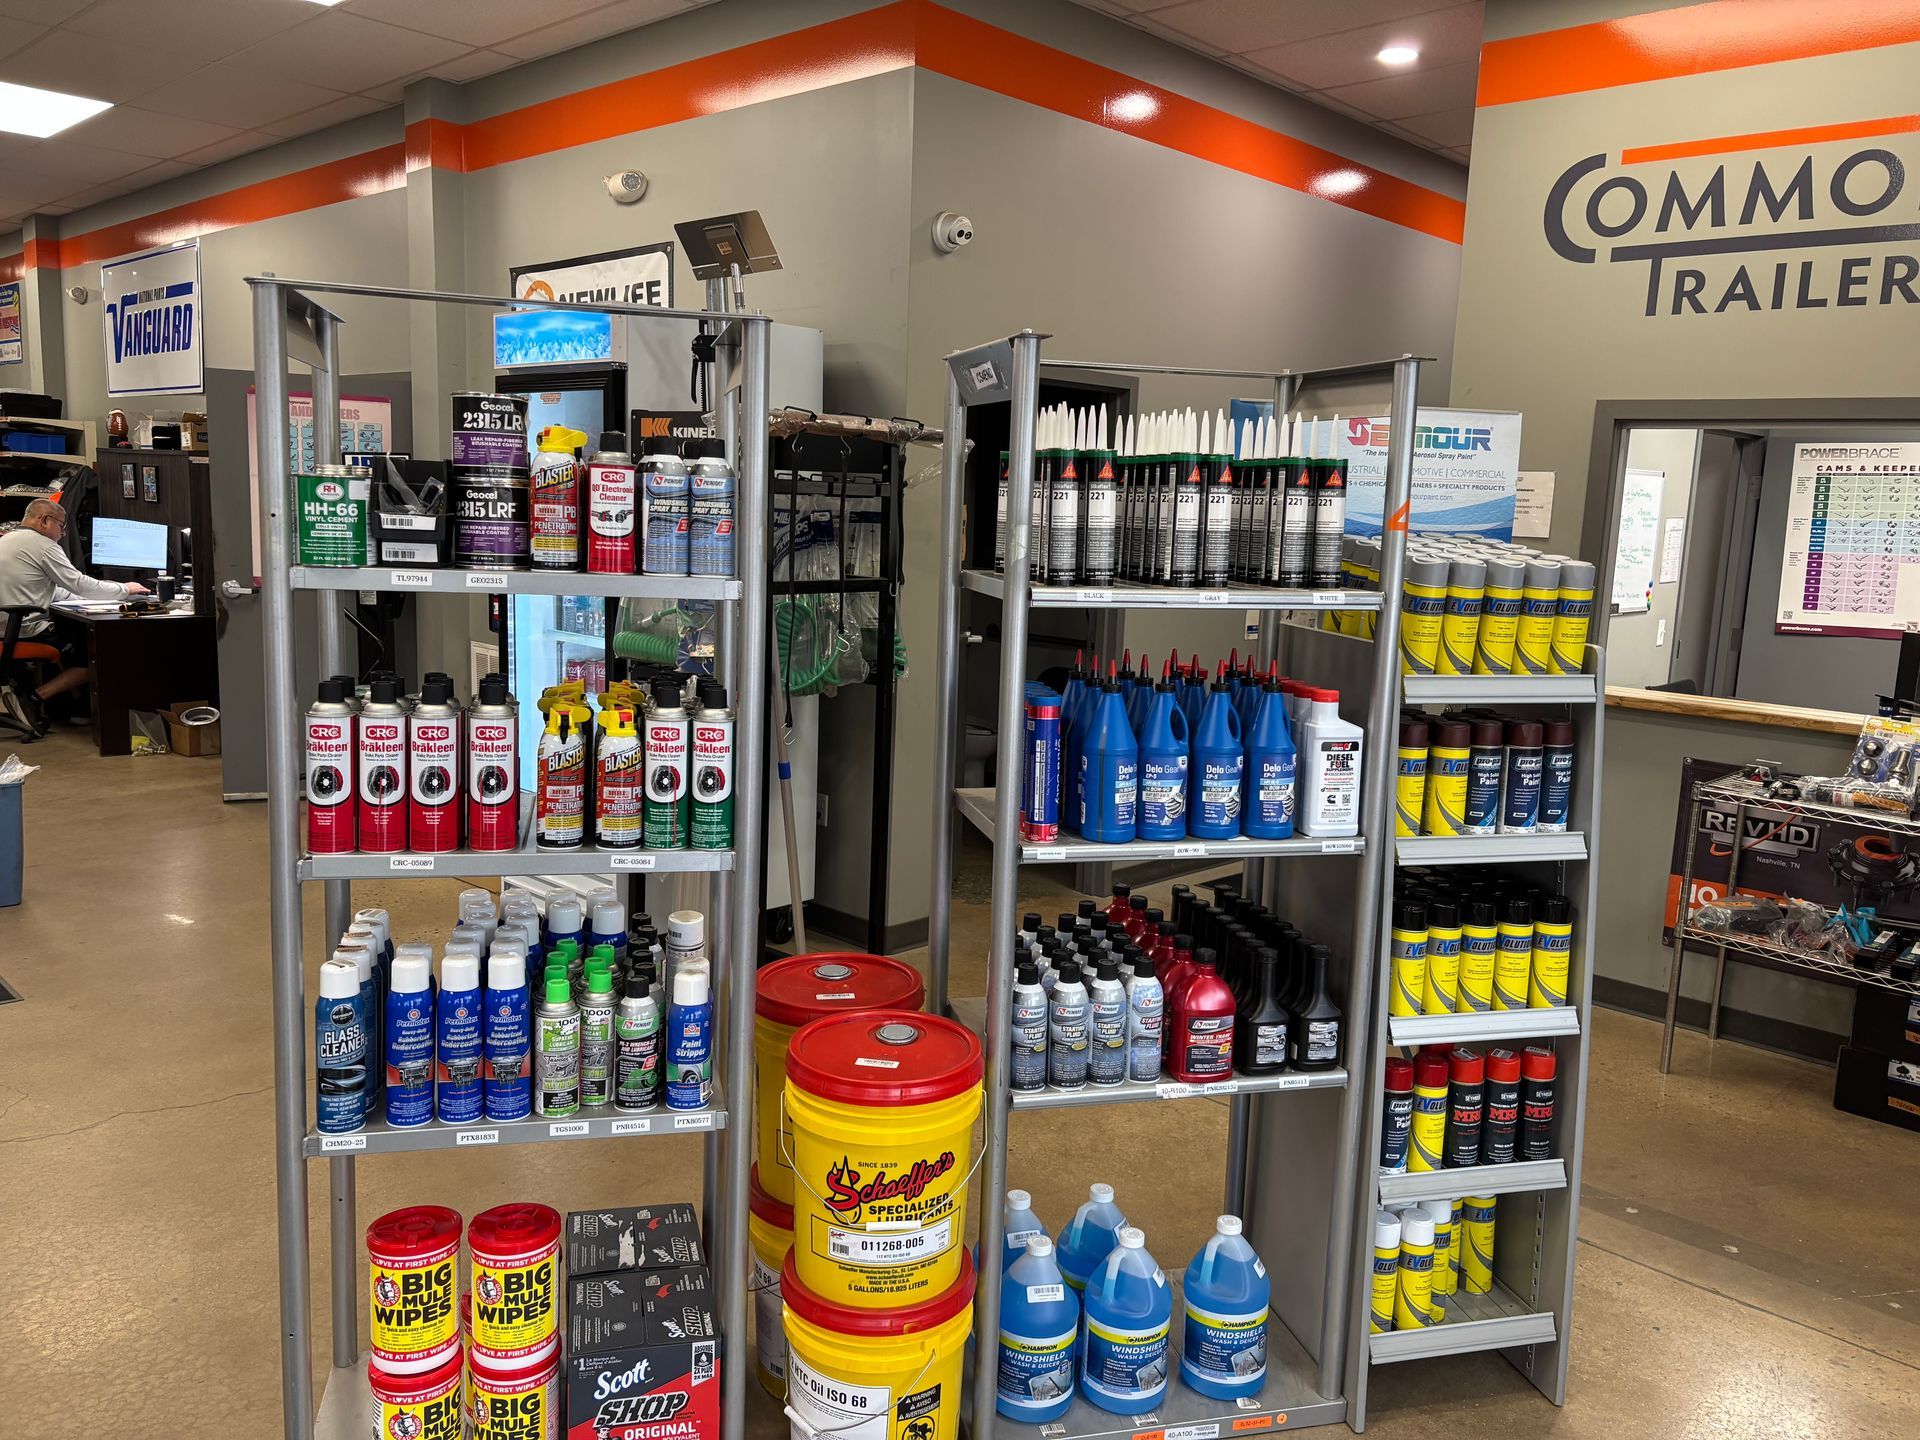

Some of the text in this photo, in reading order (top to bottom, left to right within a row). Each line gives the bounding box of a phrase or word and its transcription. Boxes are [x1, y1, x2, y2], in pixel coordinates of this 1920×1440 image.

[1544, 149, 1920, 263] COMMO
[107, 300, 193, 363] VANGUARD
[481, 401, 513, 412] Geocel
[463, 412, 501, 429] 2315
[1347, 417, 1492, 451] SEMOUR
[1800, 448, 1899, 459] POWERBRACE
[1451, 468, 1506, 479] COMMERCIAL
[466, 490, 497, 499] Geocel
[602, 484, 633, 493] Electronic
[599, 493, 627, 501] Cleaner
[1210, 496, 1225, 504] 221
[1288, 498, 1303, 506] 221
[1318, 499, 1333, 507] 221
[304, 502, 358, 516] HH-66
[488, 502, 516, 518] LRF
[1389, 498, 1410, 538] 4
[535, 522, 576, 530] PENETRATING
[477, 728, 505, 738] CRC
[651, 729, 679, 739] CRC
[697, 730, 723, 740] CRC
[1146, 764, 1179, 773] Delo Gear
[1206, 765, 1239, 774] Delo Gear
[1264, 763, 1281, 772] Delo
[1756, 856, 1788, 867] Nashville,
[489, 1014, 522, 1023] Permatex
[325, 1024, 359, 1044] GLASS
[321, 1033, 365, 1057] CLEANER
[682, 1038, 701, 1048] Paint
[676, 1047, 706, 1058] Stripper
[677, 1117, 709, 1125] PTX80577
[325, 1139, 364, 1147] CHM20-25
[461, 1133, 496, 1141] PTX81833
[824, 1152, 955, 1212] Schaeffer's
[869, 1193, 949, 1215] SPECIALIZED
[861, 1236, 924, 1251] 011268-005
[406, 1259, 427, 1268] FIRST
[507, 1258, 528, 1266] FIRST
[839, 1264, 858, 1273] Schaeffer
[402, 1263, 451, 1294] BIG
[504, 1262, 550, 1293] BIG
[854, 1283, 908, 1294] GALLONS/18.925
[908, 1279, 929, 1290] LITERS
[402, 1283, 451, 1308] MULE
[504, 1282, 550, 1307] MULE
[374, 1297, 451, 1326] WIPES
[477, 1299, 550, 1325] WIPES
[1206, 1326, 1263, 1339] WINDSHIELD
[694, 1345, 713, 1353] ABSORBE
[1111, 1338, 1167, 1354] WINDSHIELD
[1005, 1350, 1066, 1363] WINDSHIELD
[693, 1364, 713, 1374] 2X PLUS
[594, 1358, 649, 1400] Scott
[795, 1361, 867, 1408] HTC Oil ISO 68
[427, 1386, 448, 1400] FIRST
[912, 1387, 937, 1402] WARNING
[491, 1393, 540, 1418] BIG
[905, 1401, 940, 1419] AVERTISSEMENT
[915, 1398, 932, 1409] AVISO
[593, 1391, 689, 1430] SHOP
[490, 1412, 540, 1431] MULE
[624, 1422, 696, 1439] ORIGINAL
[1168, 1430, 1193, 1438] 40-A100
